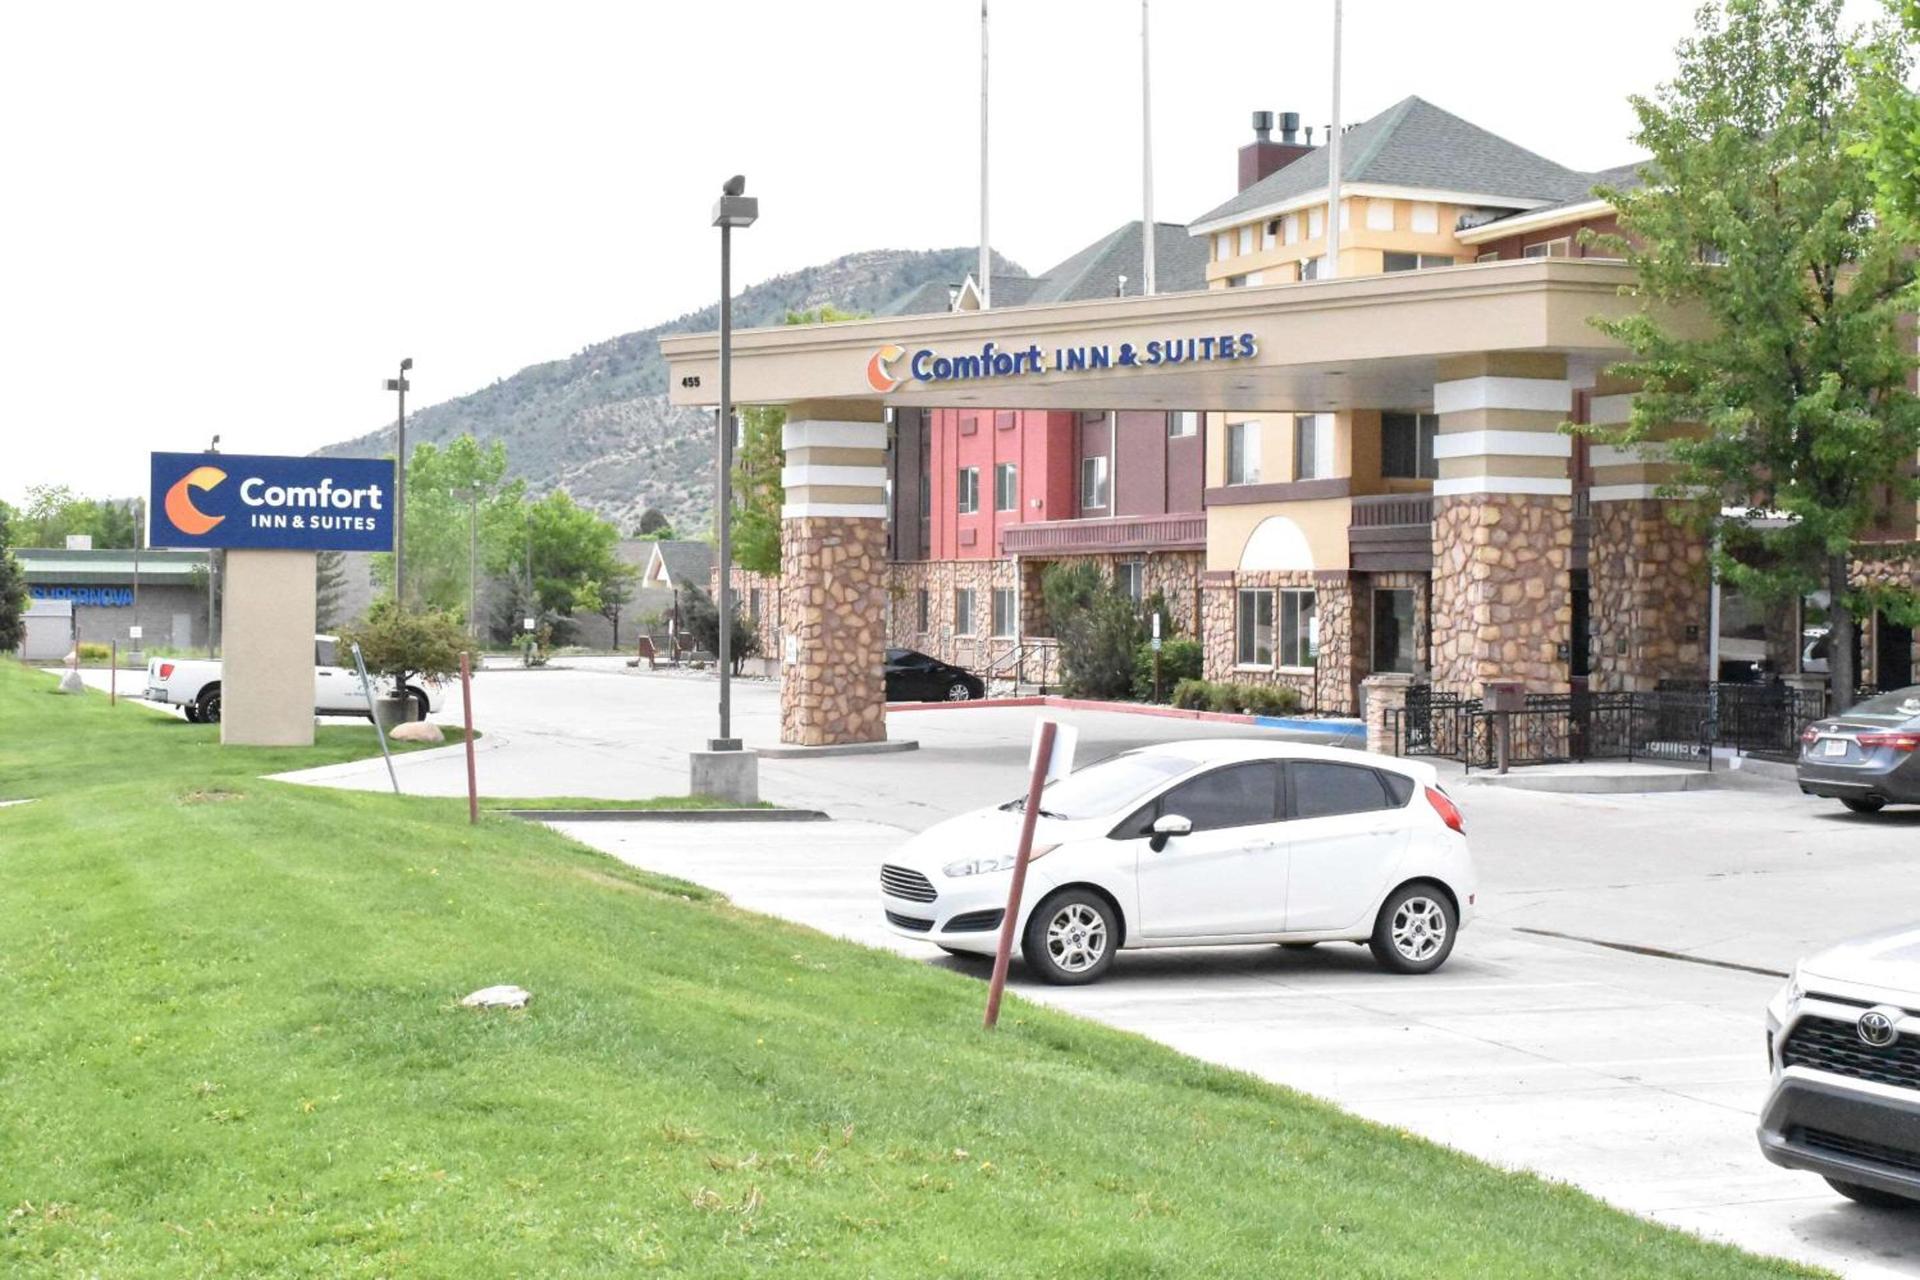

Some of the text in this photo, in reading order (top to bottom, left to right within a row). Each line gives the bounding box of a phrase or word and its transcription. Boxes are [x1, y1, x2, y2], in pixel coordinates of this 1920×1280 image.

[911, 333, 1257, 382] Comfort INN & SUITES
[681, 376, 701, 388] 455
[239, 477, 383, 510] Comfort
[251, 514, 376, 531] INN & SUITES
[31, 585, 134, 606] SUPERNOVA
